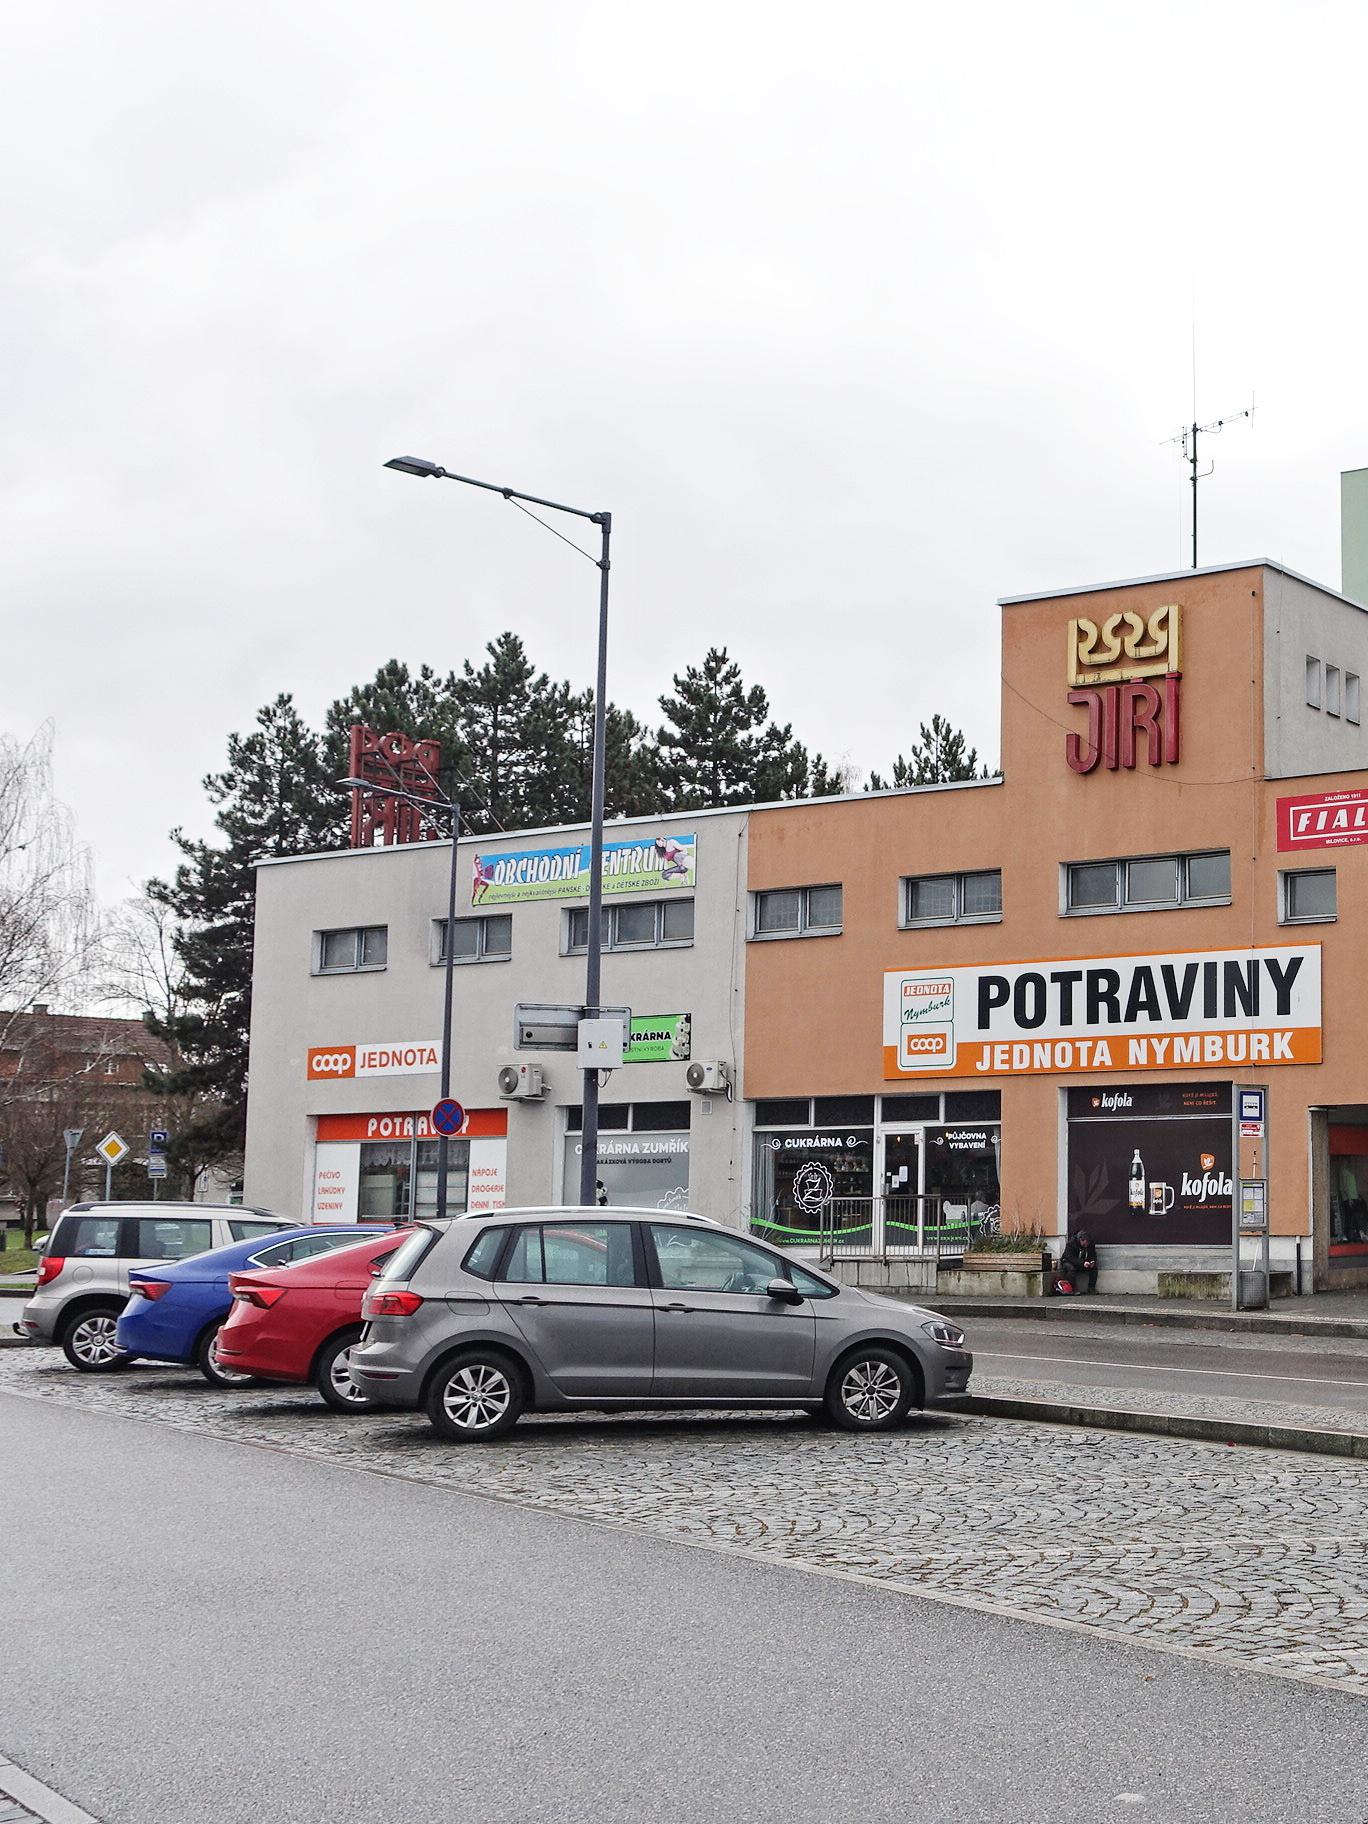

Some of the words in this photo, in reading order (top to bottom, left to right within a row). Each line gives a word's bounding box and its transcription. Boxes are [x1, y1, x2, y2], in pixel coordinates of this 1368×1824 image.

[493, 848, 583, 886] OBCHODNÍ
[588, 845, 666, 877] ENTRUM
[904, 983, 952, 996] JEDNOTA
[977, 956, 1305, 1030] POTRAVINY
[904, 996, 952, 1021] Nymburk
[630, 1029, 671, 1041] KRÁRNA
[910, 1036, 944, 1053] coop
[976, 1039, 1112, 1072] JEDNOTA
[1128, 1031, 1294, 1065] NYMBURK
[312, 1053, 352, 1075] coop
[360, 1048, 438, 1069] JEDNOTA
[1101, 1092, 1133, 1111] kofola
[367, 1115, 469, 1138] POTRAY
[785, 1135, 843, 1148] CUKRÁRNA
[947, 1131, 987, 1141] PŮJČOVNA
[574, 1140, 640, 1154] CRÁRNA
[642, 1138, 689, 1153] ZUMŘÍK
[949, 1140, 986, 1150] VYBAVENÍ
[596, 1157, 627, 1165] AKÁZKOVÁ
[318, 1171, 341, 1179] PEČIVO
[471, 1168, 498, 1176] NÁPOJE
[471, 1184, 505, 1192] DROGERIE
[1180, 1171, 1233, 1202] kofola
[317, 1202, 343, 1210] UZENINY
[470, 1200, 489, 1209] DENNÍ
